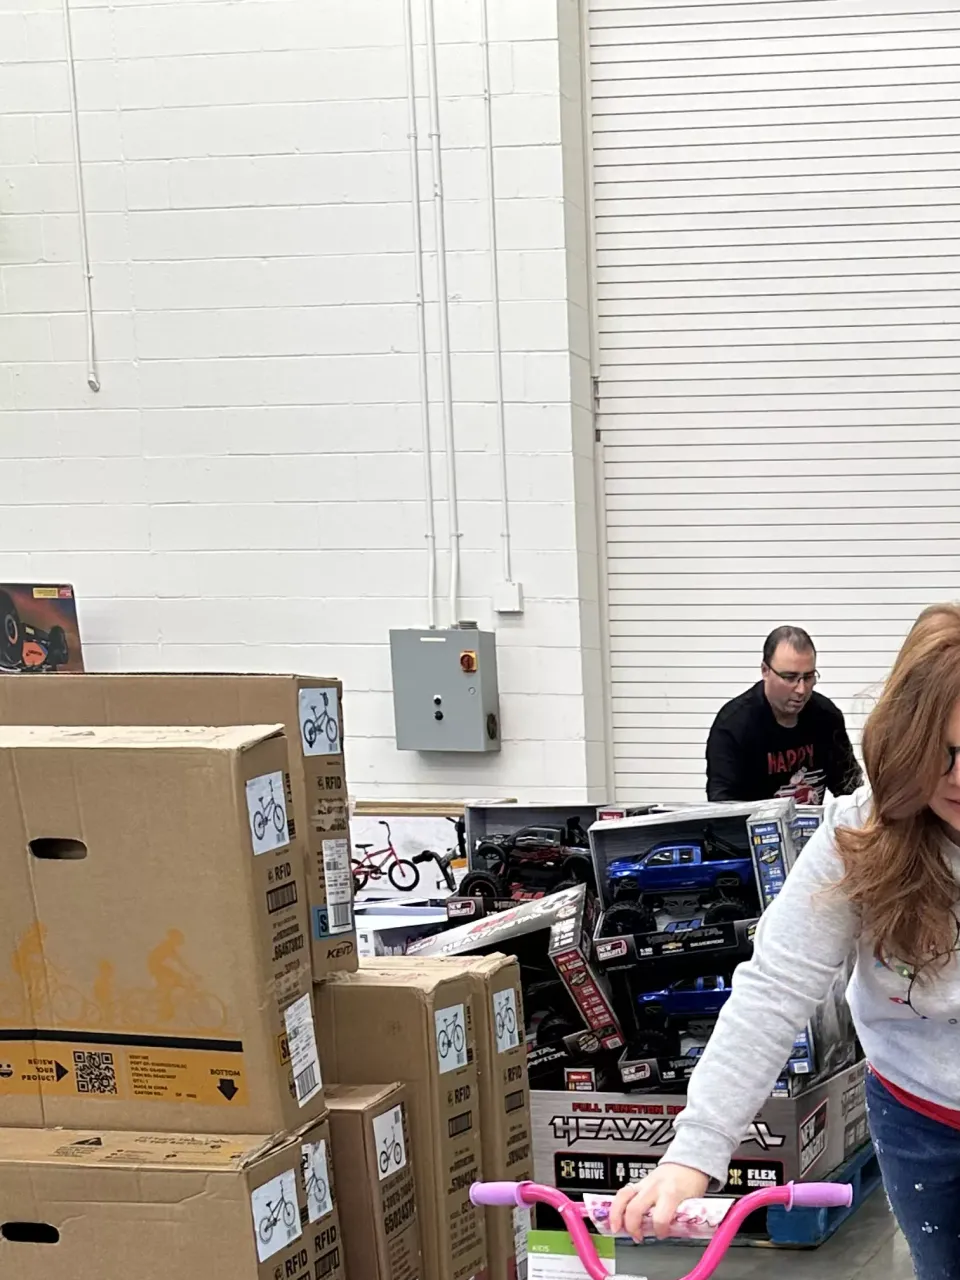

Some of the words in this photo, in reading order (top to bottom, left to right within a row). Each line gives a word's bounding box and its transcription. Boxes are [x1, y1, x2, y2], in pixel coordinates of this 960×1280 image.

[767, 744, 814, 775] HAPPY
[325, 775, 342, 790] RFID
[274, 862, 292, 880] RFID
[526, 1046, 556, 1059] ETAL
[527, 1051, 568, 1068] APTOR
[210, 1068, 241, 1077] BOTTOM
[455, 1084, 471, 1104] RFID
[572, 1102, 602, 1113] FULL
[605, 1103, 664, 1115] FUNCTION
[549, 1115, 662, 1147] HEAVY
[578, 1160, 604, 1169] 4-WHEEL
[578, 1168, 605, 1180] DRIVE
[747, 1168, 777, 1180] FLEX
[314, 1225, 337, 1253] RFID
[285, 1248, 308, 1278] RFID
